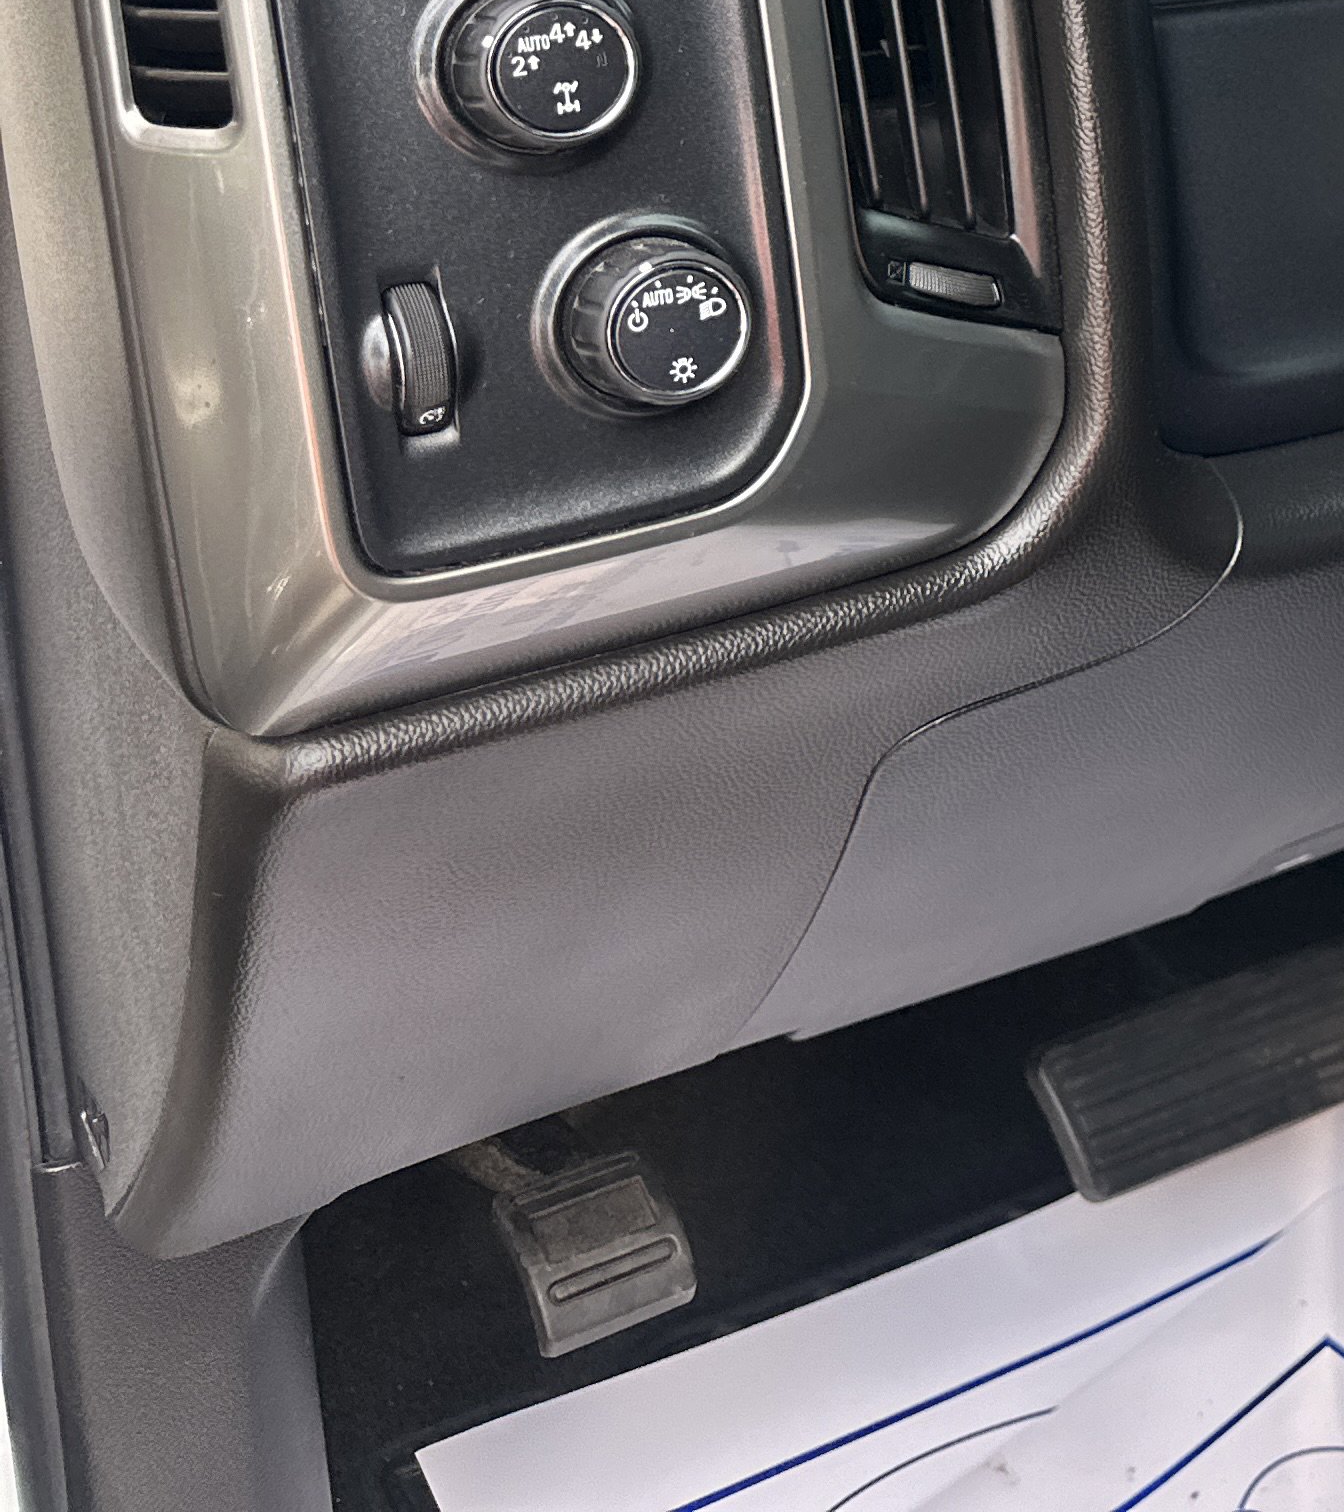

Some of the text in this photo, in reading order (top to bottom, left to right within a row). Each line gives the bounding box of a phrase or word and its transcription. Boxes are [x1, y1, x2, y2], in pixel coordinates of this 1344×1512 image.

[517, 22, 566, 53] AUTO 4
[575, 30, 592, 50] 4
[511, 56, 528, 77] 2
[642, 288, 675, 308] AUTO
